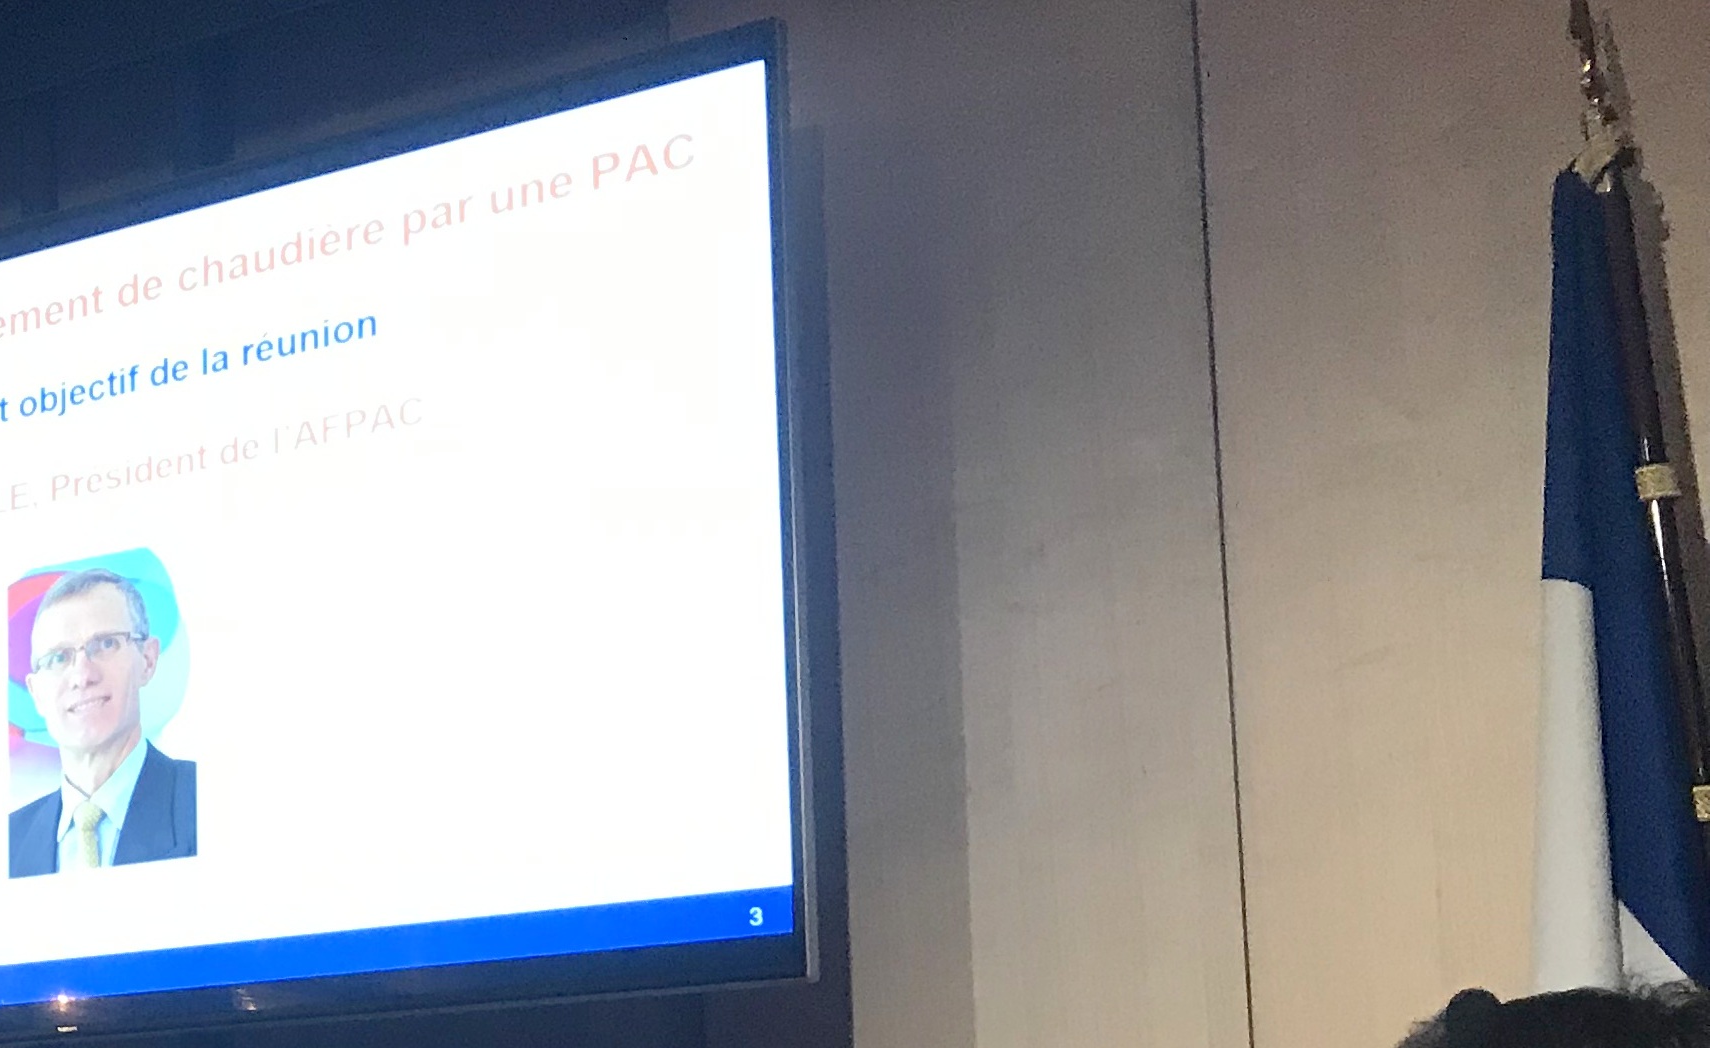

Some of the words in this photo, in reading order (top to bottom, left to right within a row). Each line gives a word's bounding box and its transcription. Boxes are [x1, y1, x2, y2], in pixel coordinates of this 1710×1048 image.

[117, 274, 163, 306] de
[177, 219, 385, 292] chaudière
[403, 195, 474, 245] par
[490, 171, 573, 214] une
[591, 133, 696, 190] PAC
[19, 364, 140, 417] objectif
[150, 356, 189, 387] de
[201, 347, 229, 375] la
[242, 314, 379, 366] réunion
[219, 435, 259, 467] de
[749, 906, 764, 927] 3
